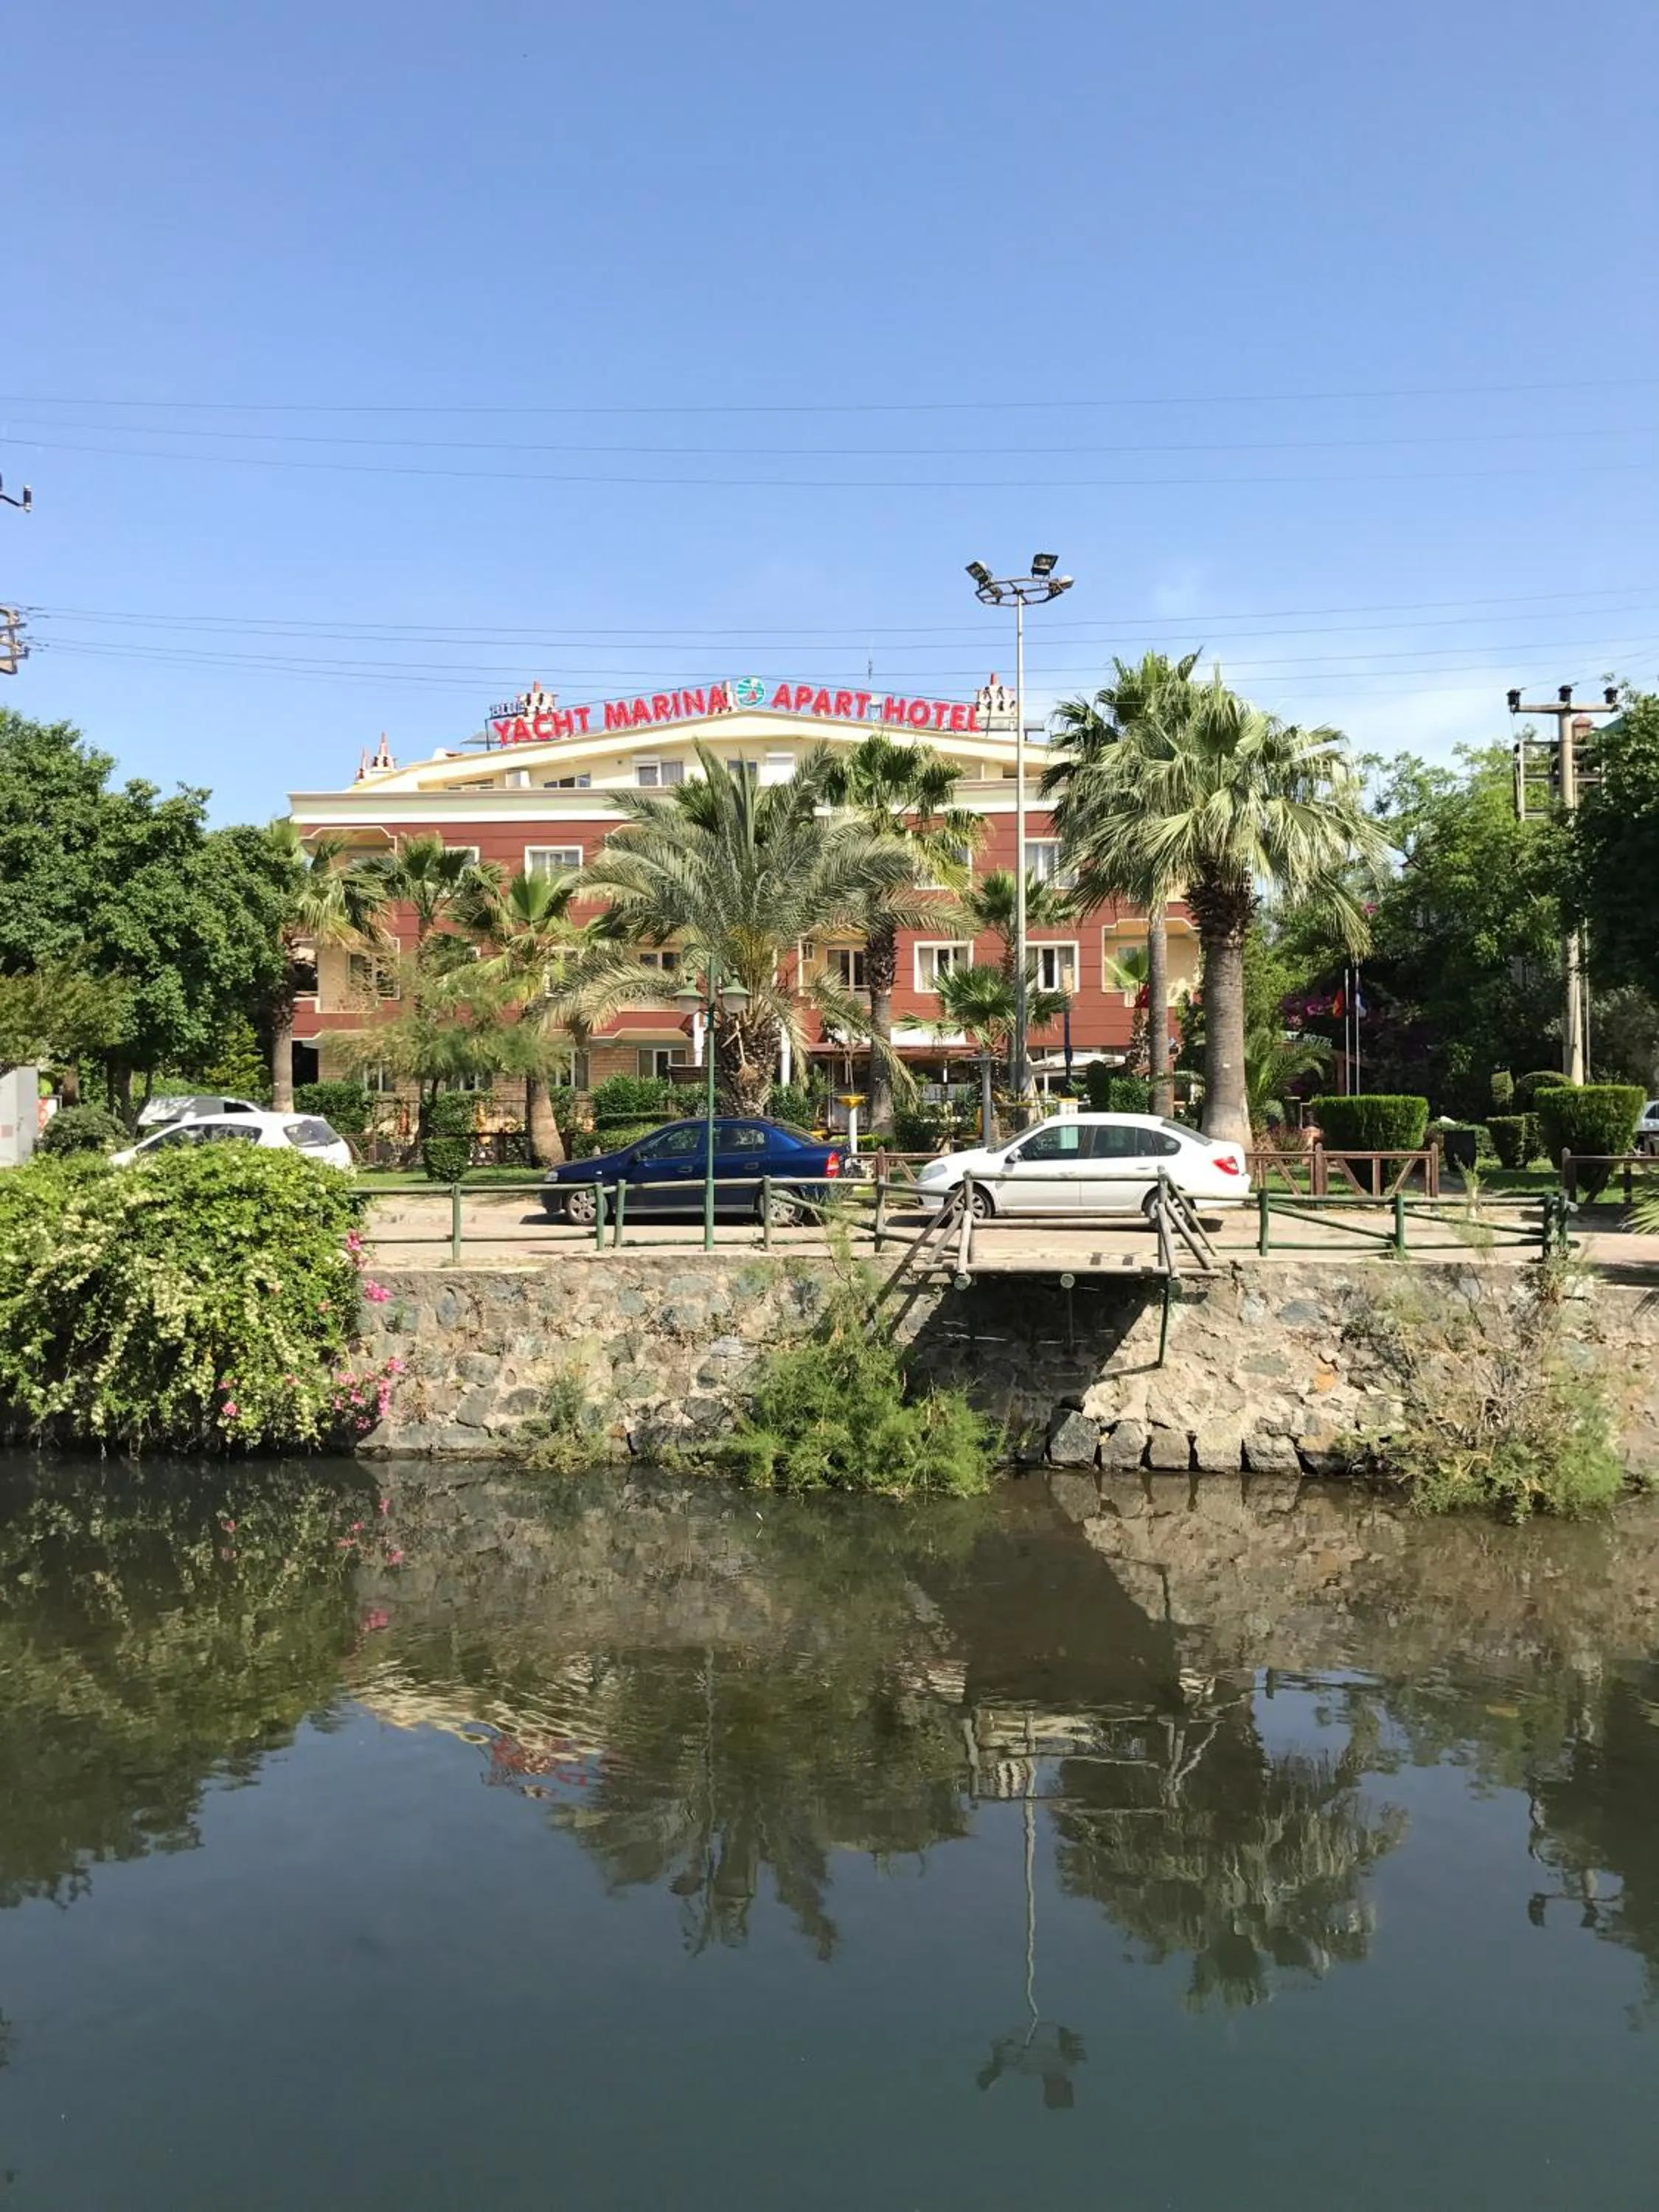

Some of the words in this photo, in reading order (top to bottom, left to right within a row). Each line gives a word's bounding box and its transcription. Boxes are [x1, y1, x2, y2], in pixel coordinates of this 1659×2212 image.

[493, 706, 590, 747] YACHT
[604, 685, 728, 731] MARINA
[771, 684, 872, 719] APART
[883, 697, 981, 731] HOTEL
